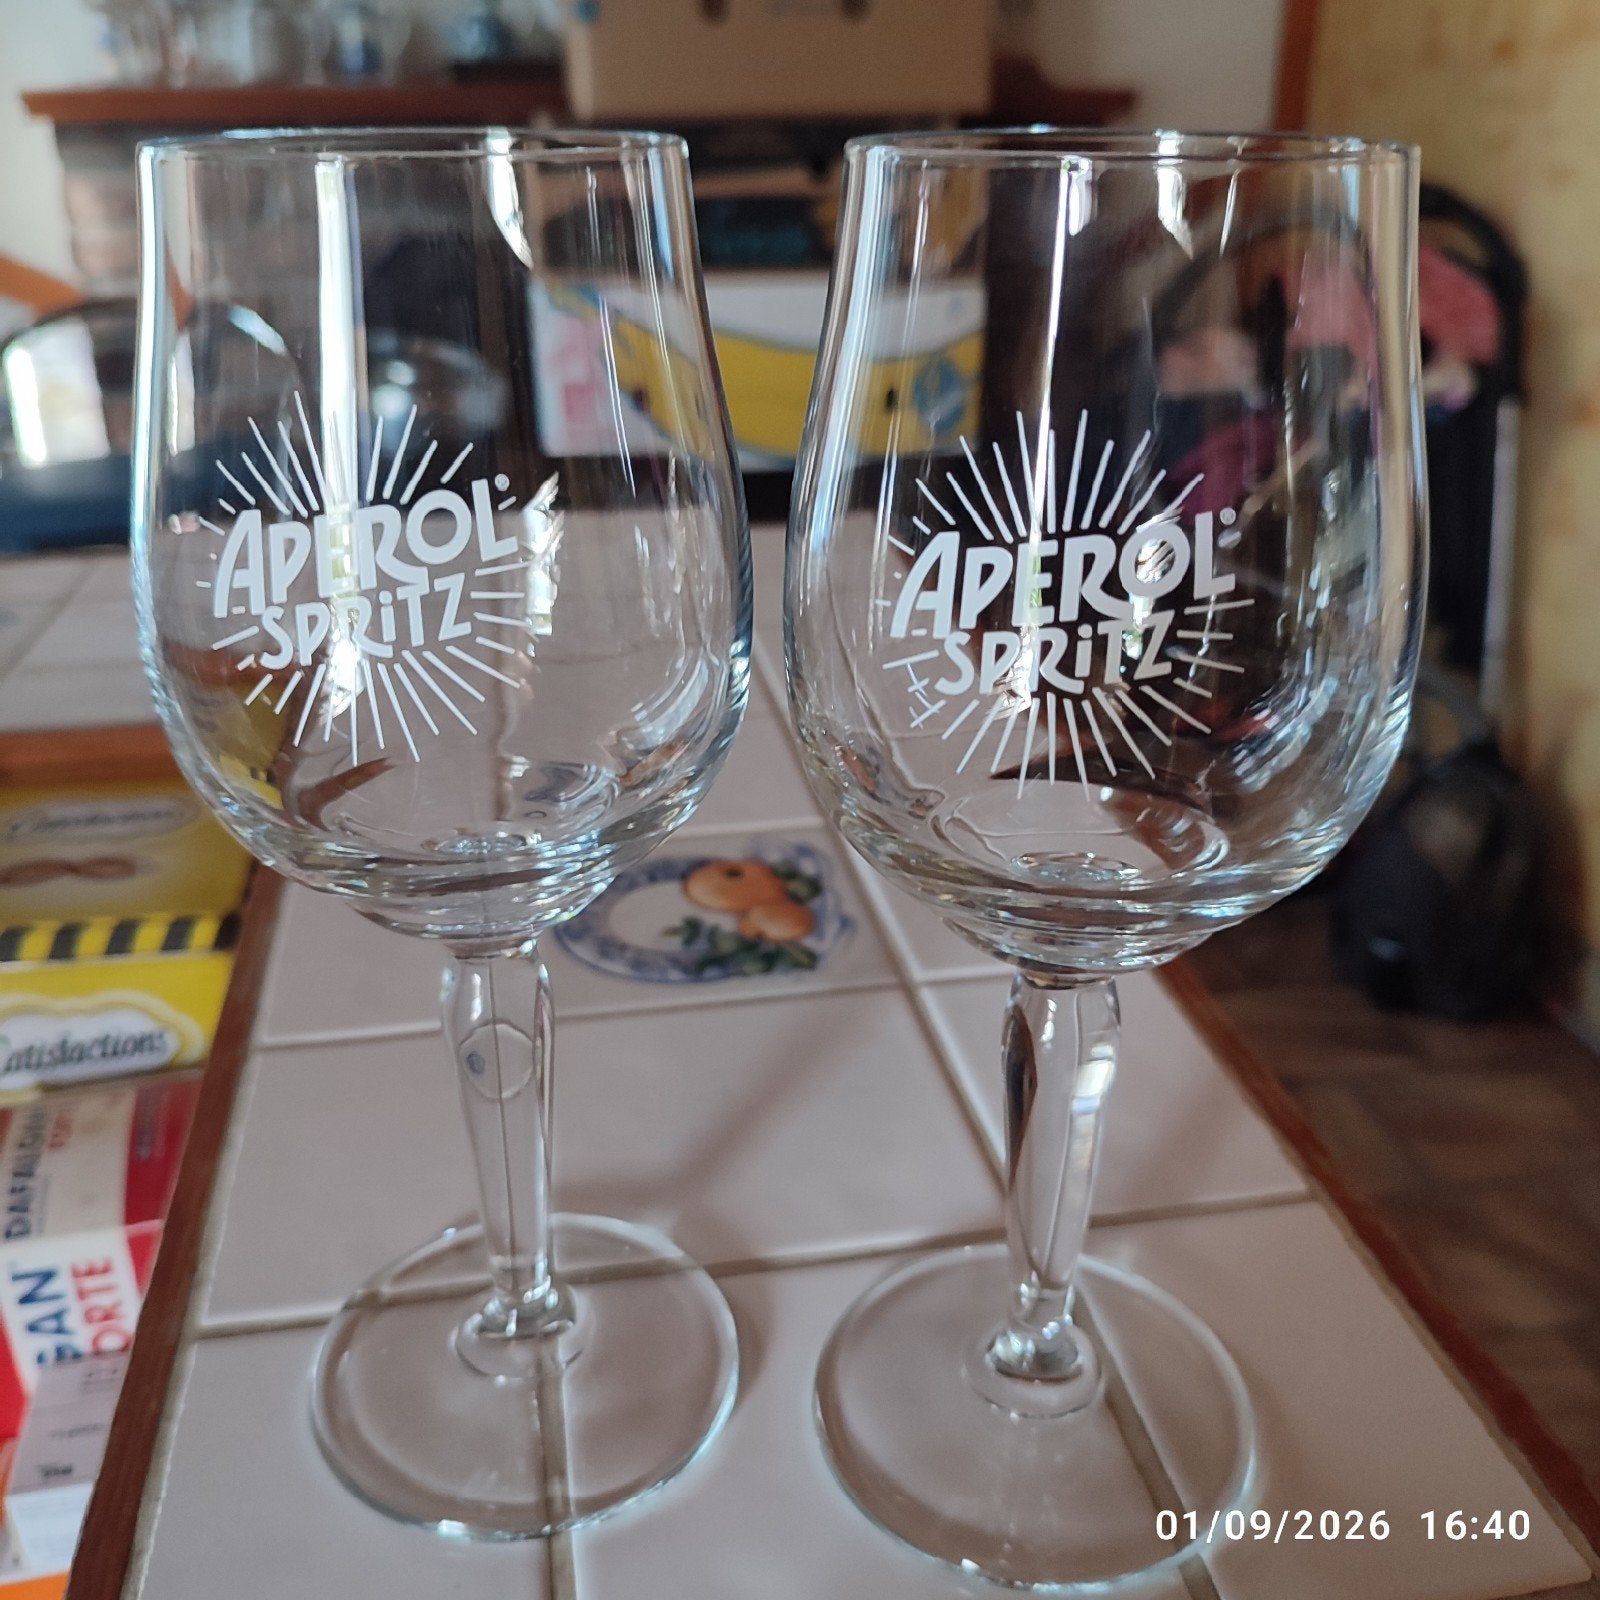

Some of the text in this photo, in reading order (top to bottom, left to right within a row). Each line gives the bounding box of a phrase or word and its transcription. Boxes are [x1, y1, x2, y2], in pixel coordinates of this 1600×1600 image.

[213, 478, 518, 618] APEROL
[889, 510, 1236, 639] APEROL
[0, 1025, 167, 1073] atisfactions
